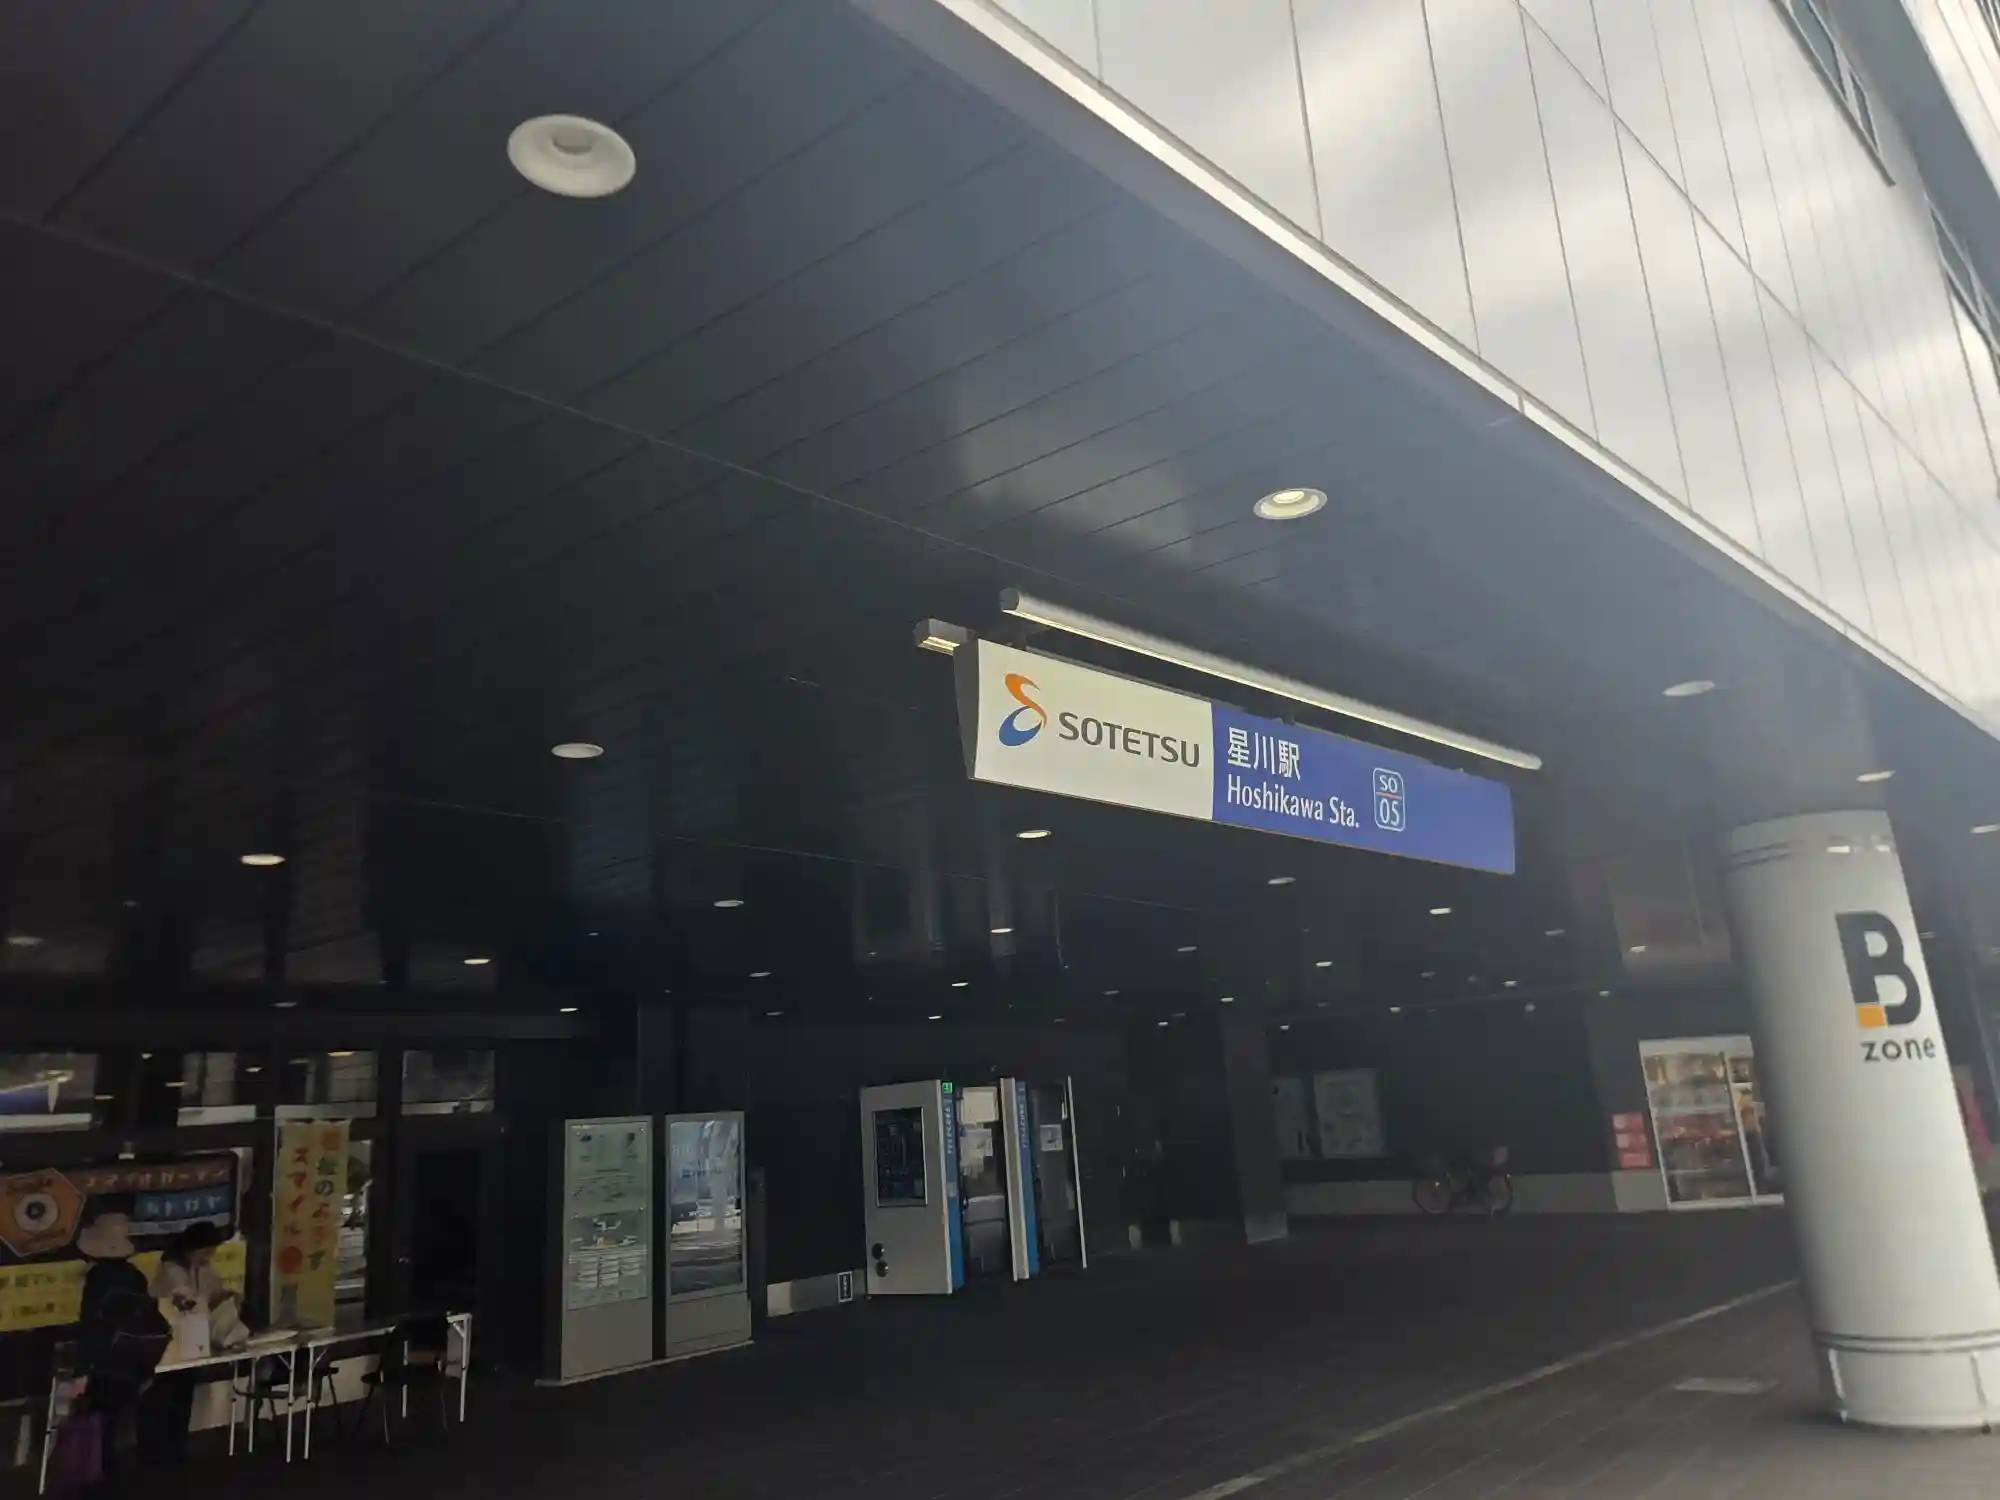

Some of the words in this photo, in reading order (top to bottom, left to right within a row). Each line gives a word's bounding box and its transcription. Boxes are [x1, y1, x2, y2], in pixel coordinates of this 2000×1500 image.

[1059, 712, 1199, 767] SOTETSU
[1228, 727, 1300, 780] 星川駅
[1227, 773, 1323, 821] Hoshikawa
[1329, 796, 1360, 828] Sta.
[1379, 774, 1398, 793] SO
[1379, 799, 1400, 826] 05
[1835, 911, 1921, 1028] B
[1860, 1037, 1936, 1062] zone
